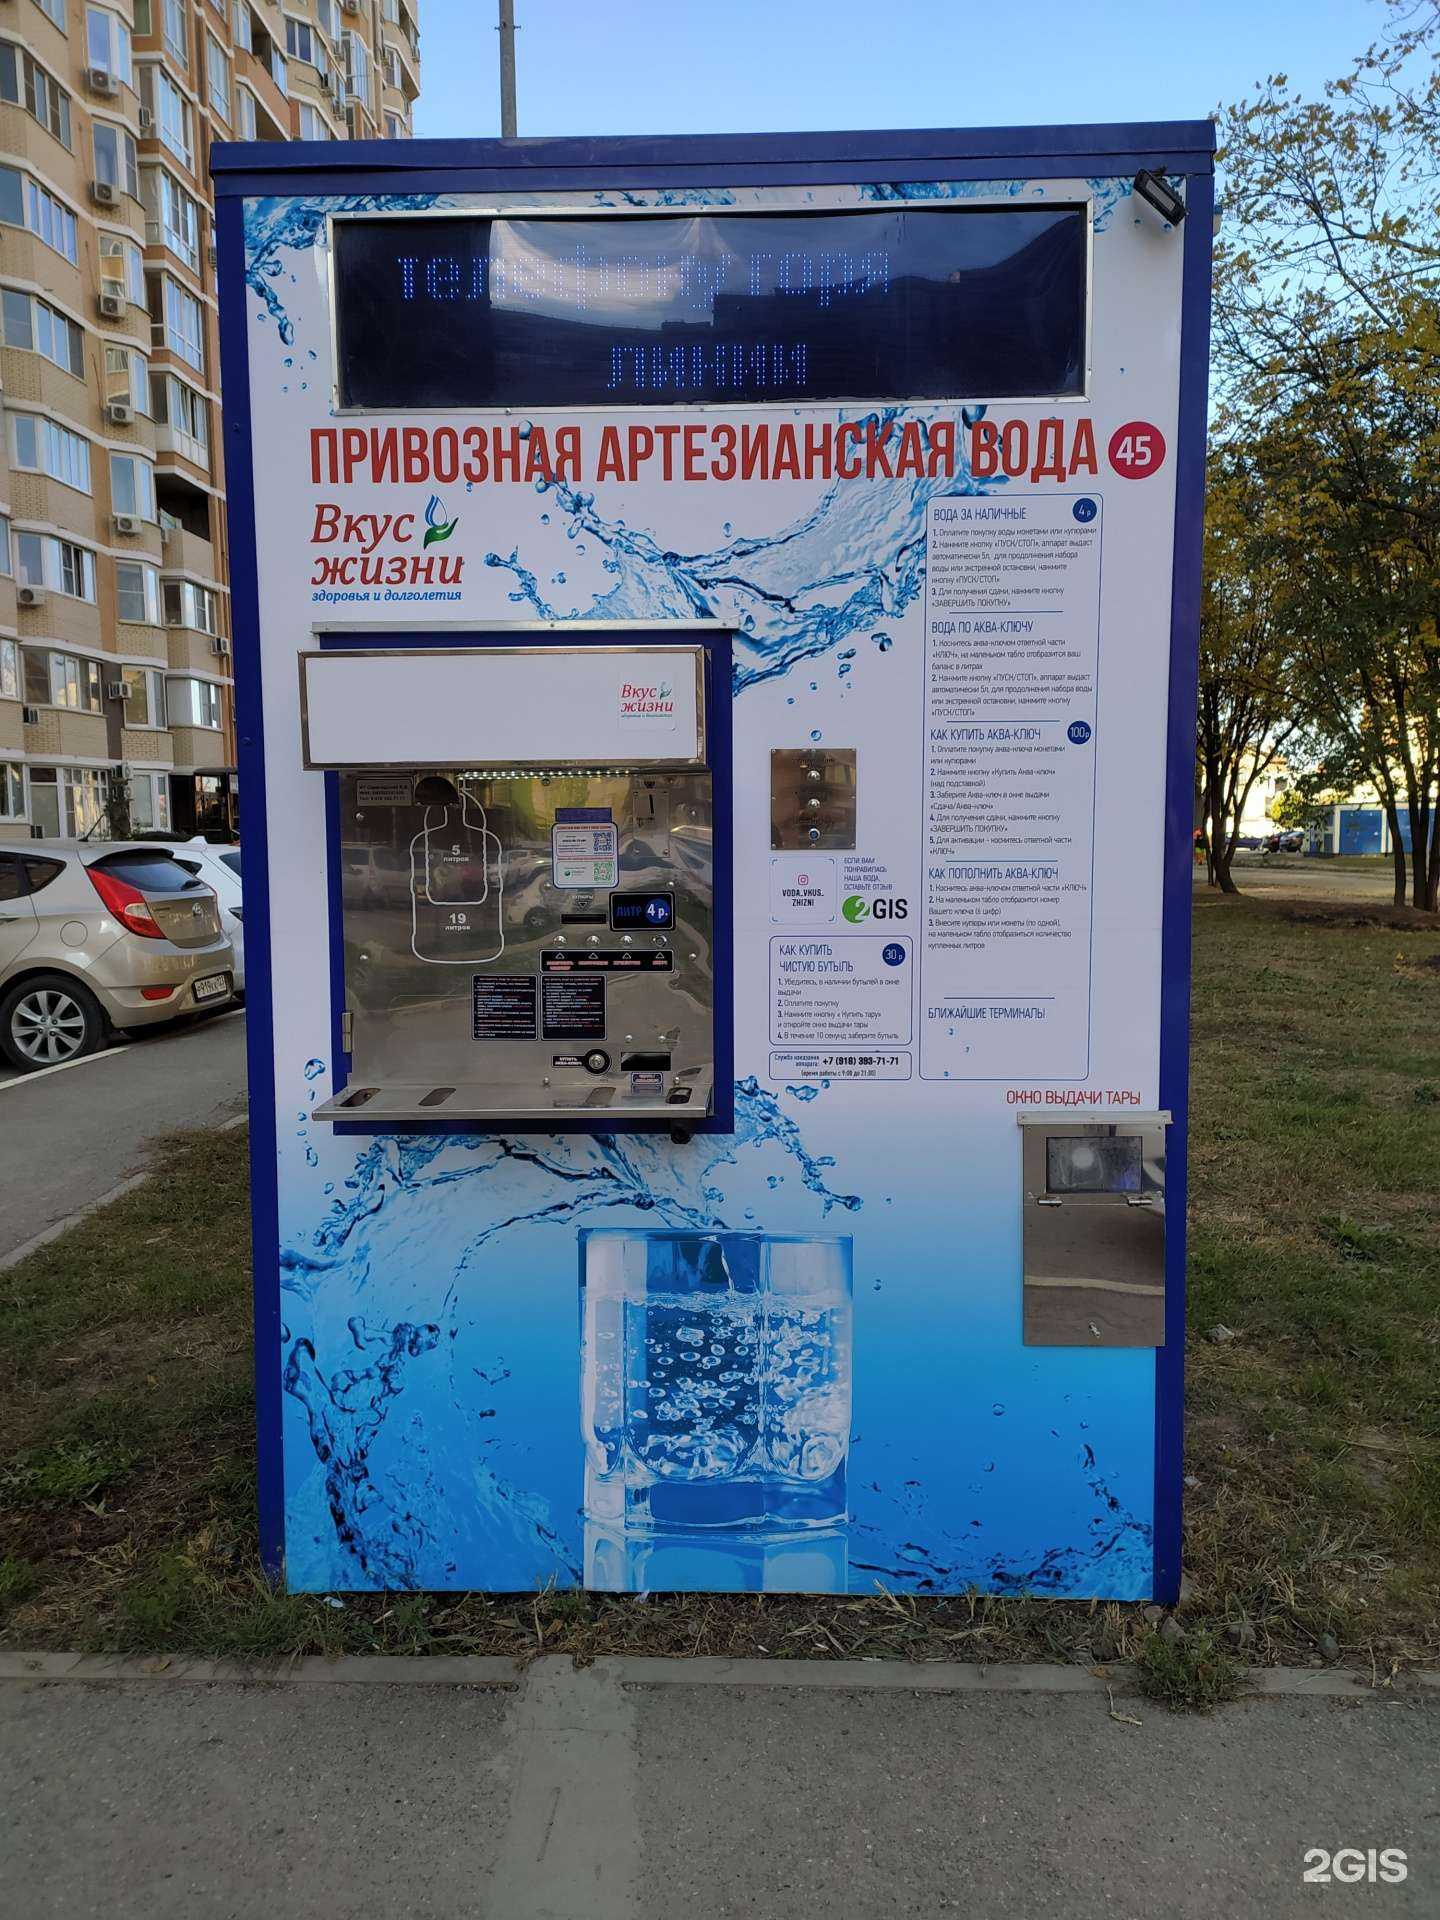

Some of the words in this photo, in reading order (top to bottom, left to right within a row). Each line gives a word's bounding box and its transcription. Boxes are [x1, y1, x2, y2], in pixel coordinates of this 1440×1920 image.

[310, 426, 581, 483] ПРИВОЗНАЯ
[597, 421, 954, 481] АРТЕЗИАНСКАЯ
[971, 418, 1099, 483] ВОДА
[1115, 436, 1152, 466] 45
[934, 509, 958, 522] ВОДА
[961, 508, 972, 521] ЗА
[975, 507, 1027, 521] НАЛИЧНЫЕ
[1079, 505, 1085, 515] 4
[311, 504, 415, 553] Вкус
[311, 555, 463, 586] жизни
[312, 591, 370, 603] здоровья
[373, 592, 382, 600] и
[384, 590, 462, 602] долголетия
[932, 622, 956, 635] ВОДА
[959, 621, 971, 633] ПО
[974, 621, 1034, 633] АКВА-КЛЮЧУ
[622, 684, 657, 701] Вкус
[621, 702, 673, 712] жизни
[930, 729, 948, 740] КАК
[951, 729, 984, 741] КУПИТЬ
[987, 728, 1041, 740] АКВА-КЛЮЧ
[452, 845, 460, 856] 5
[928, 869, 946, 879] КАК
[949, 868, 1003, 879] ПОПОЛНИТЬ
[1005, 868, 1059, 879] АКВА-КЛЮЧ
[648, 904, 656, 917] 4
[450, 913, 467, 924] 19
[780, 945, 796, 955] КАК
[799, 944, 833, 955] КУПИТЬ
[885, 950, 896, 960] 30
[780, 961, 815, 972] ЧИСТУЮ
[818, 961, 854, 972] БУТЫЛЬ
[928, 1005, 986, 1019] БЛИЖАЙШИЕ
[989, 1008, 1045, 1018] ТЕРМИНАЛЫ
[823, 1057, 833, 1065] +7
[1007, 1090, 1042, 1104] ОКНО
[1046, 1090, 1102, 1106] ВЫДАЧИ
[1106, 1091, 1141, 1104] ТАРЫ
